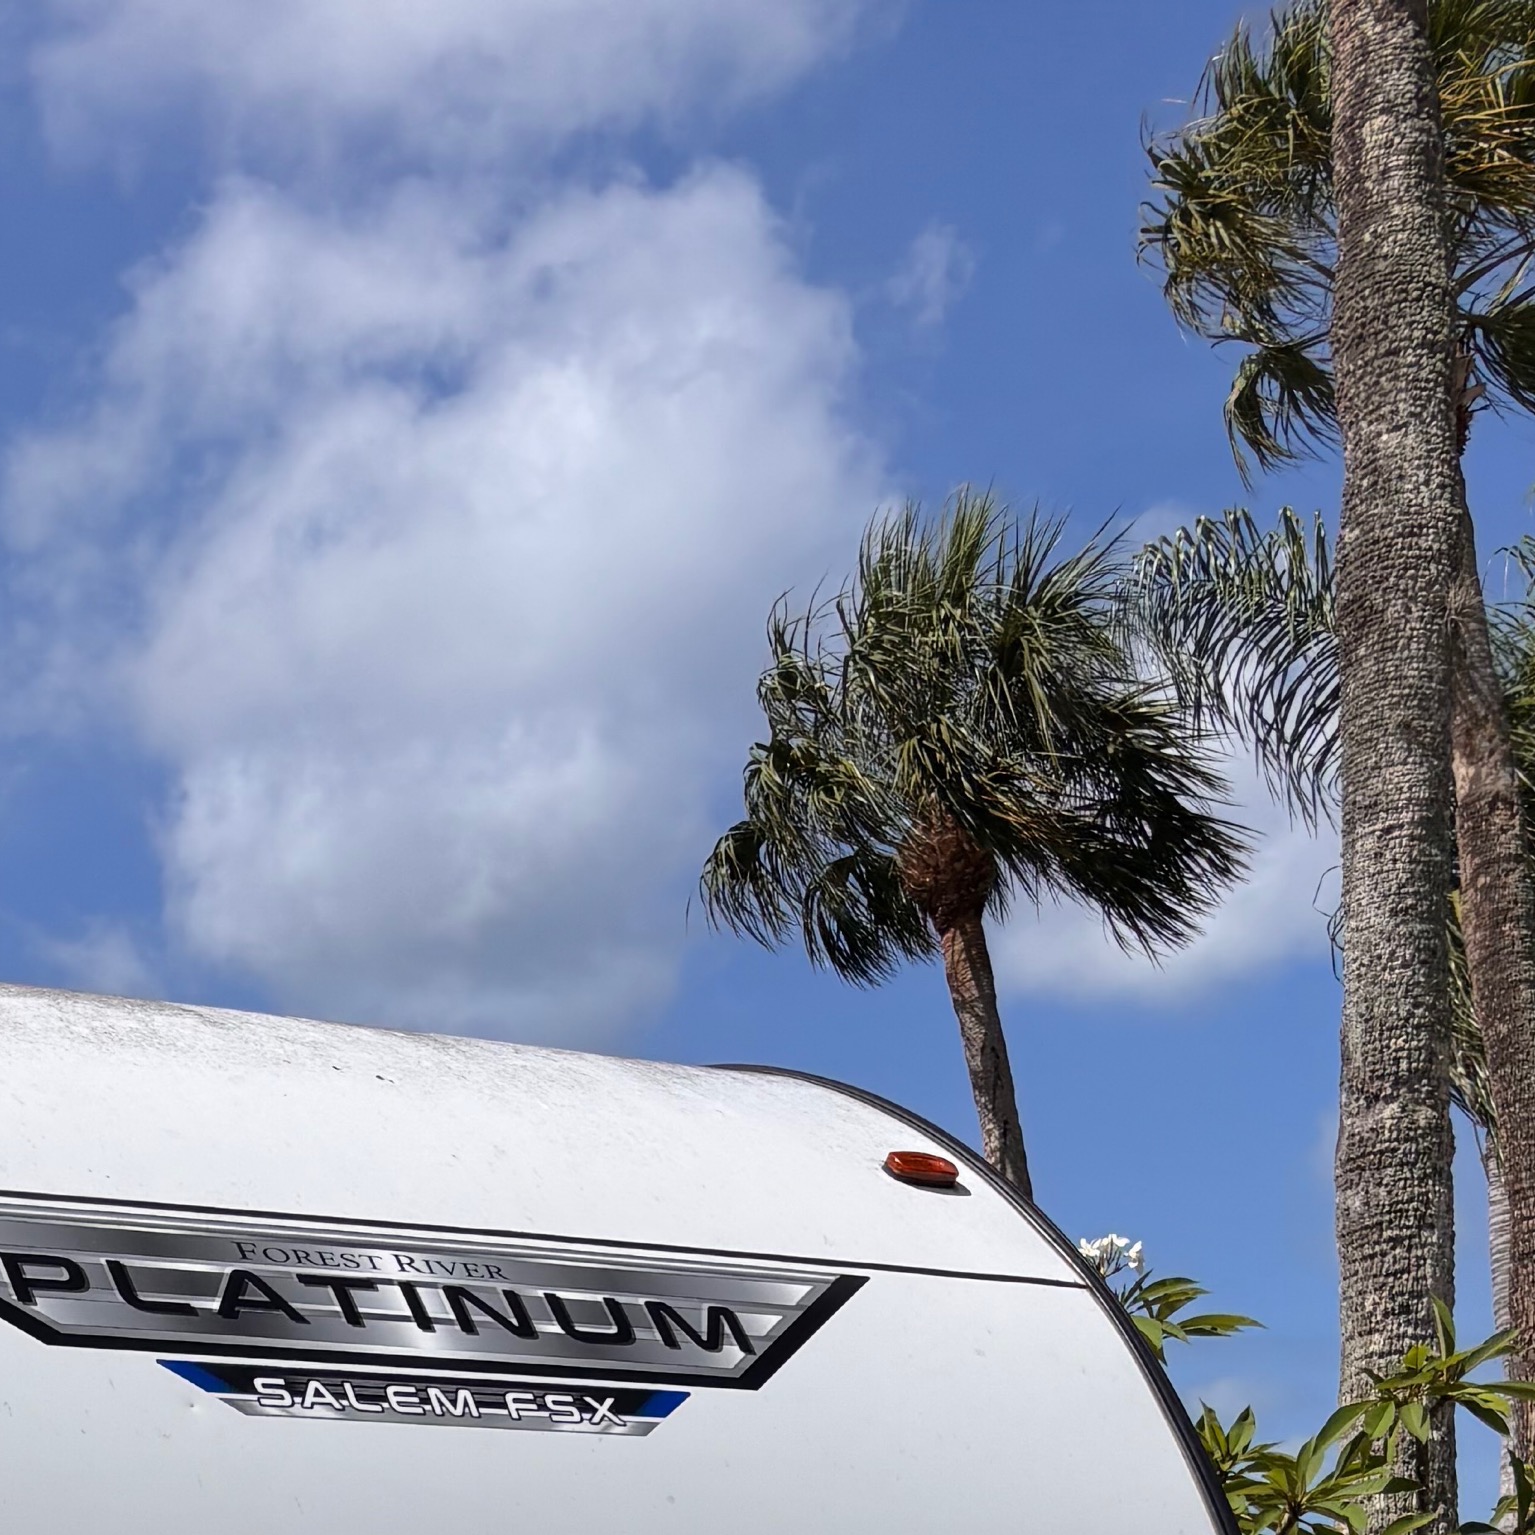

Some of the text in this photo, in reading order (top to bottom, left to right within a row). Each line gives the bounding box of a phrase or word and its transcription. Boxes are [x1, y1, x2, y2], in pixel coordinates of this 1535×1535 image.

[231, 1240, 511, 1281] FOREST RIVER
[252, 1376, 628, 1427] SALEM FSX
